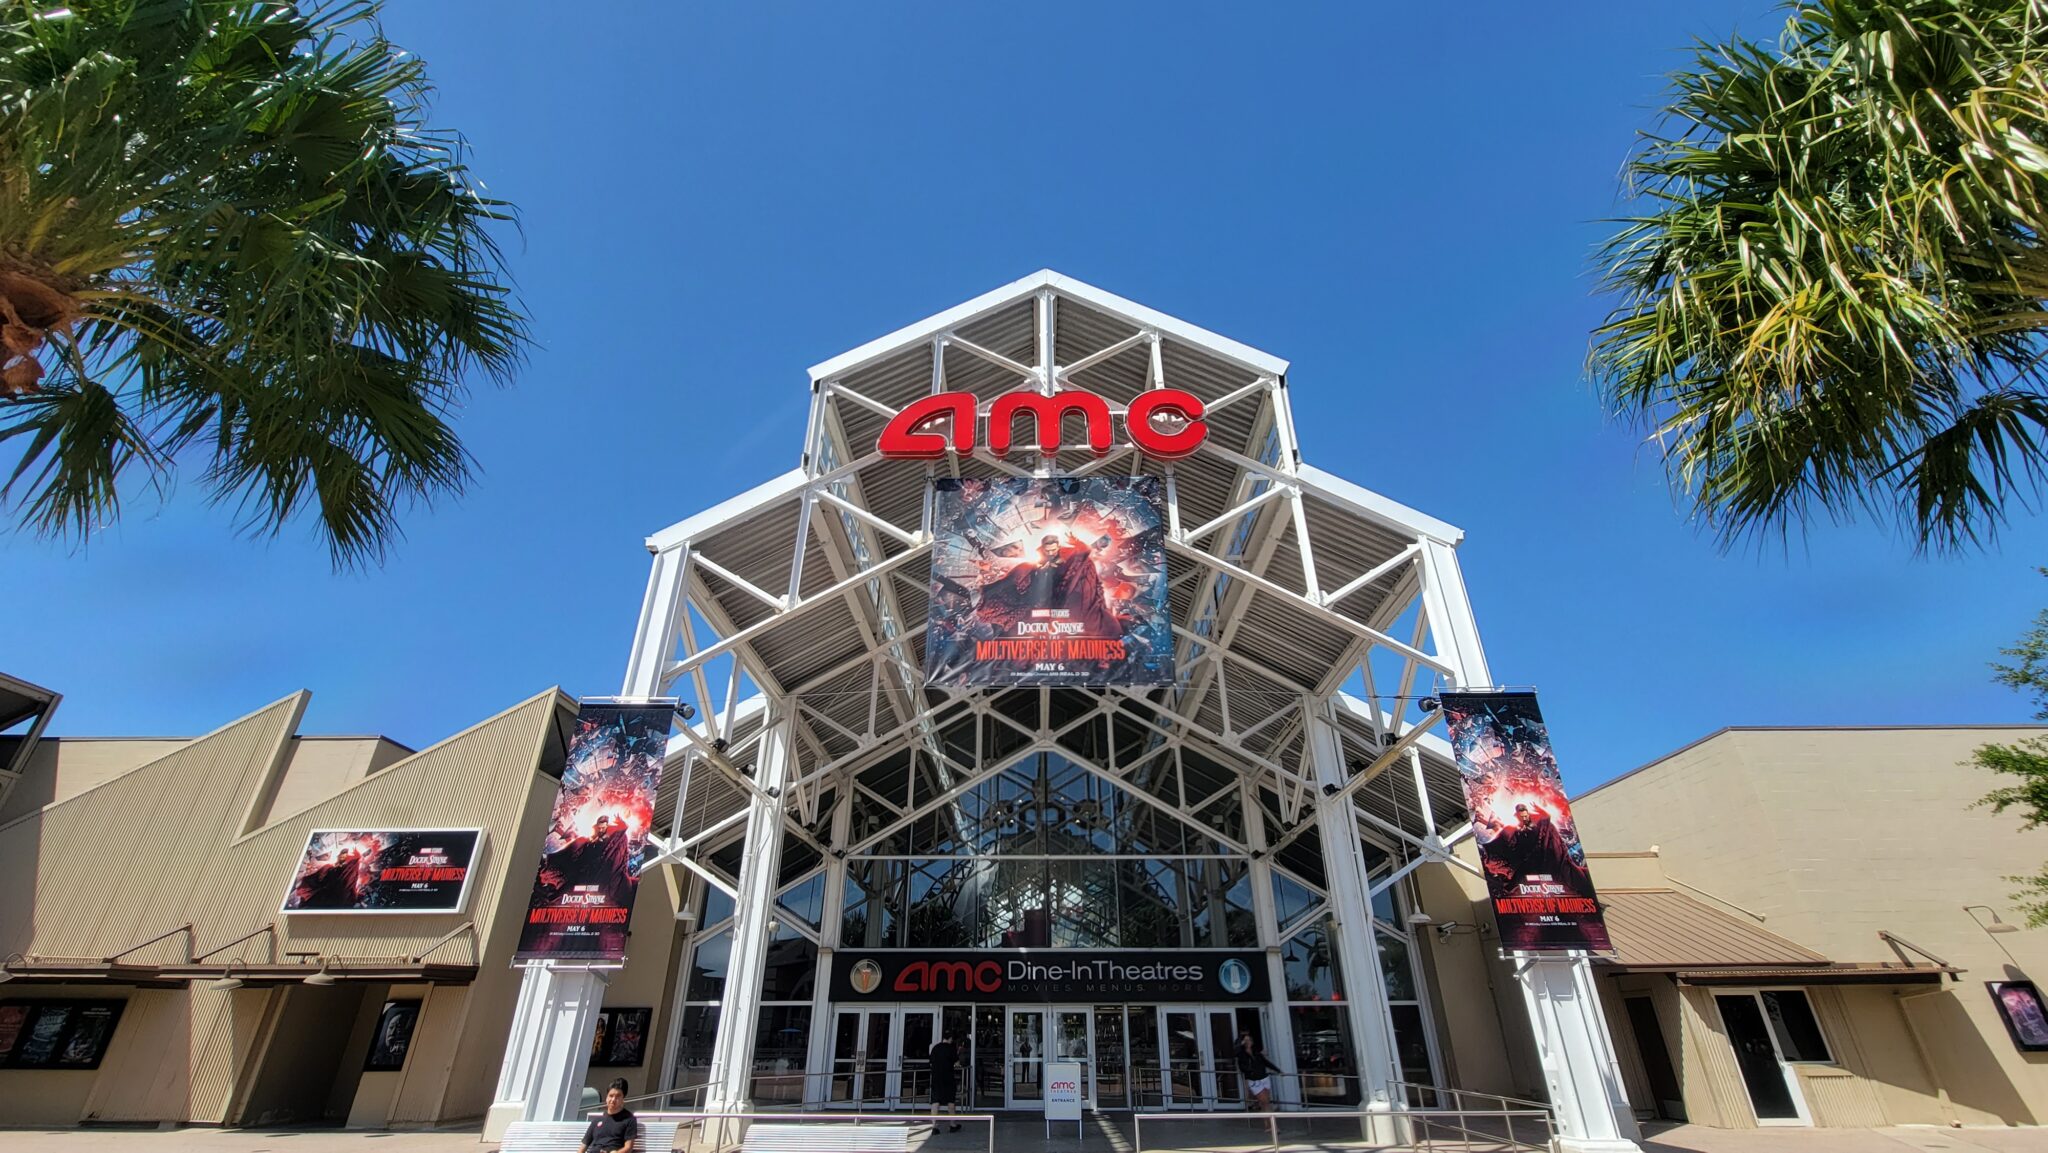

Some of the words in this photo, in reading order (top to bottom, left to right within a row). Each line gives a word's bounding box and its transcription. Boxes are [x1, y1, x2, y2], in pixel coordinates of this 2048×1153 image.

[976, 640, 1048, 661] MULTIVERSE
[1051, 640, 1065, 660] OF
[1068, 640, 1126, 660] MADNESS
[1036, 663, 1056, 671] MAY
[1057, 663, 1064, 671] 6
[1496, 898, 1546, 913] MULTIVERSE
[1545, 898, 1556, 913] OF
[1556, 898, 1596, 913] MADNESS
[530, 908, 578, 923] MULTIVERSE
[579, 908, 590, 923] OF
[589, 908, 628, 923] MADNESS
